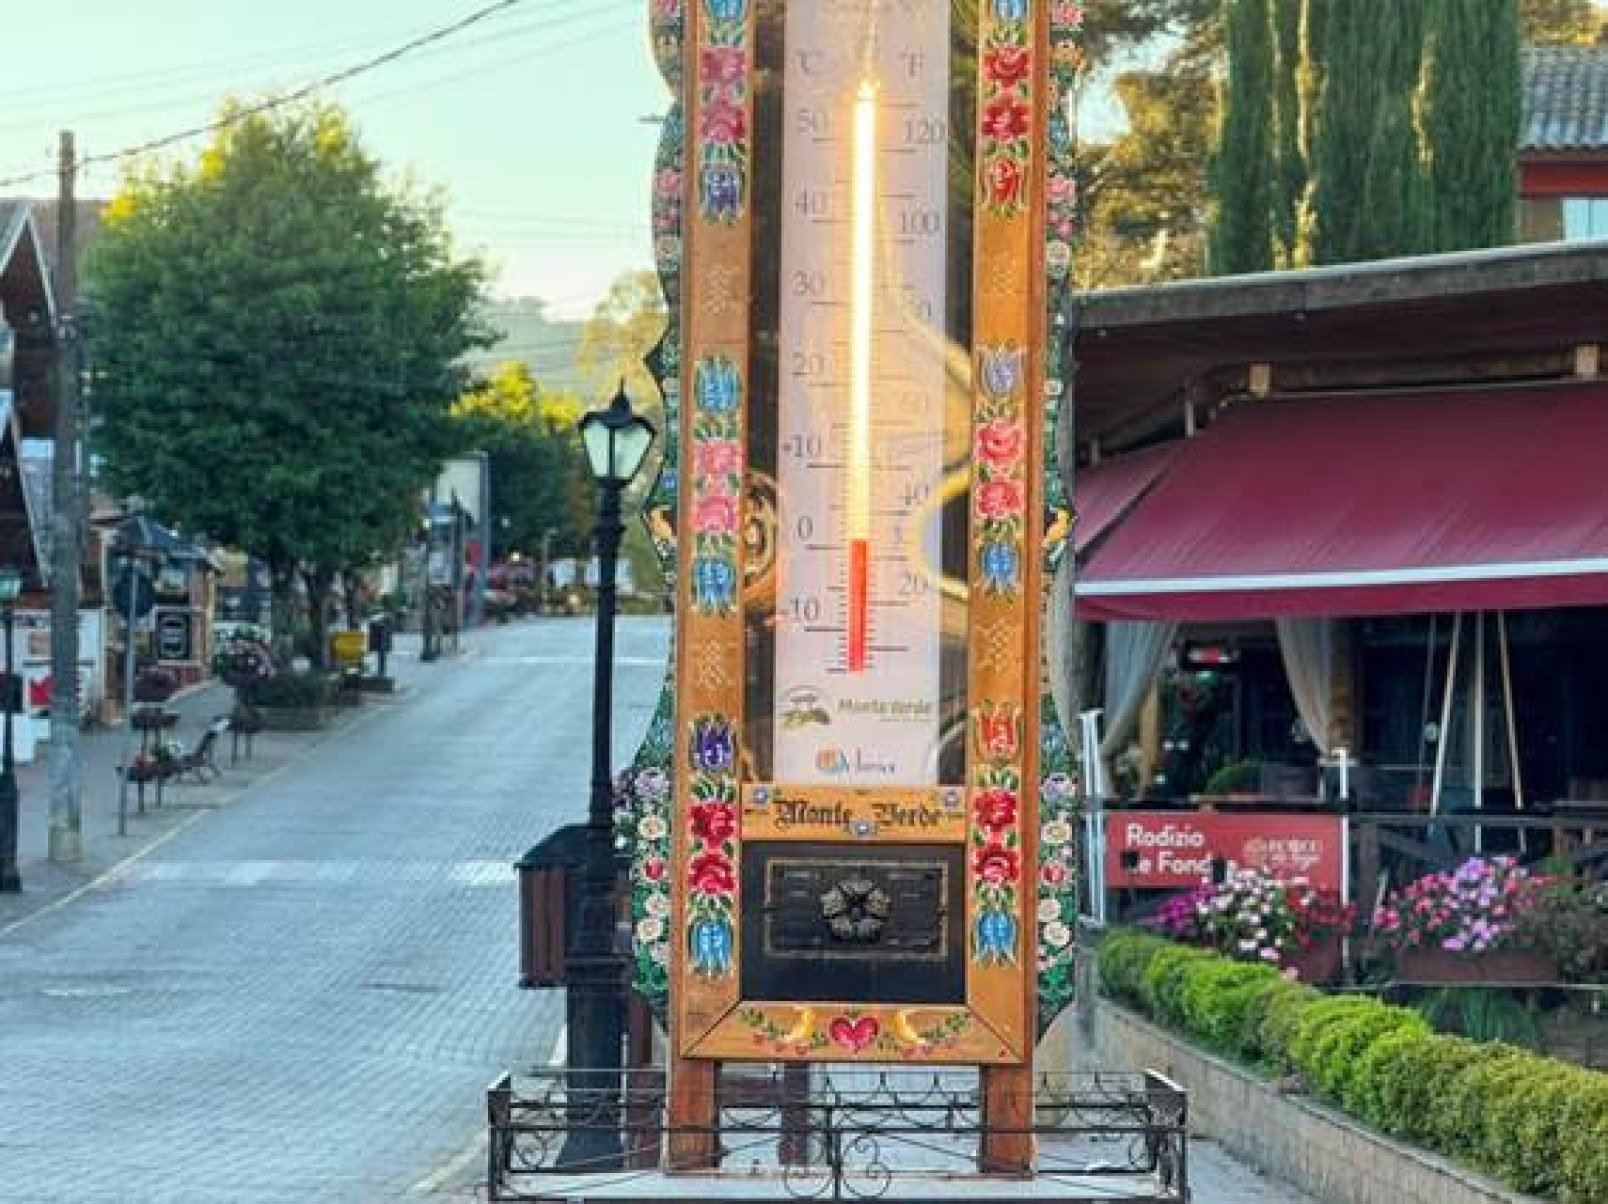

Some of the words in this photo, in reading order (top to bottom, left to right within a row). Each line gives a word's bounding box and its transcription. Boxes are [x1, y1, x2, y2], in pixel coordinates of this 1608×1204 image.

[797, 110, 828, 134] 50
[903, 116, 945, 144] 120
[794, 188, 828, 215] 40
[900, 207, 940, 235] 100
[791, 271, 826, 296] 30
[792, 351, 824, 378] 20
[798, 516, 813, 541] 0
[774, 799, 853, 830] Monte
[872, 803, 942, 828] Verde
